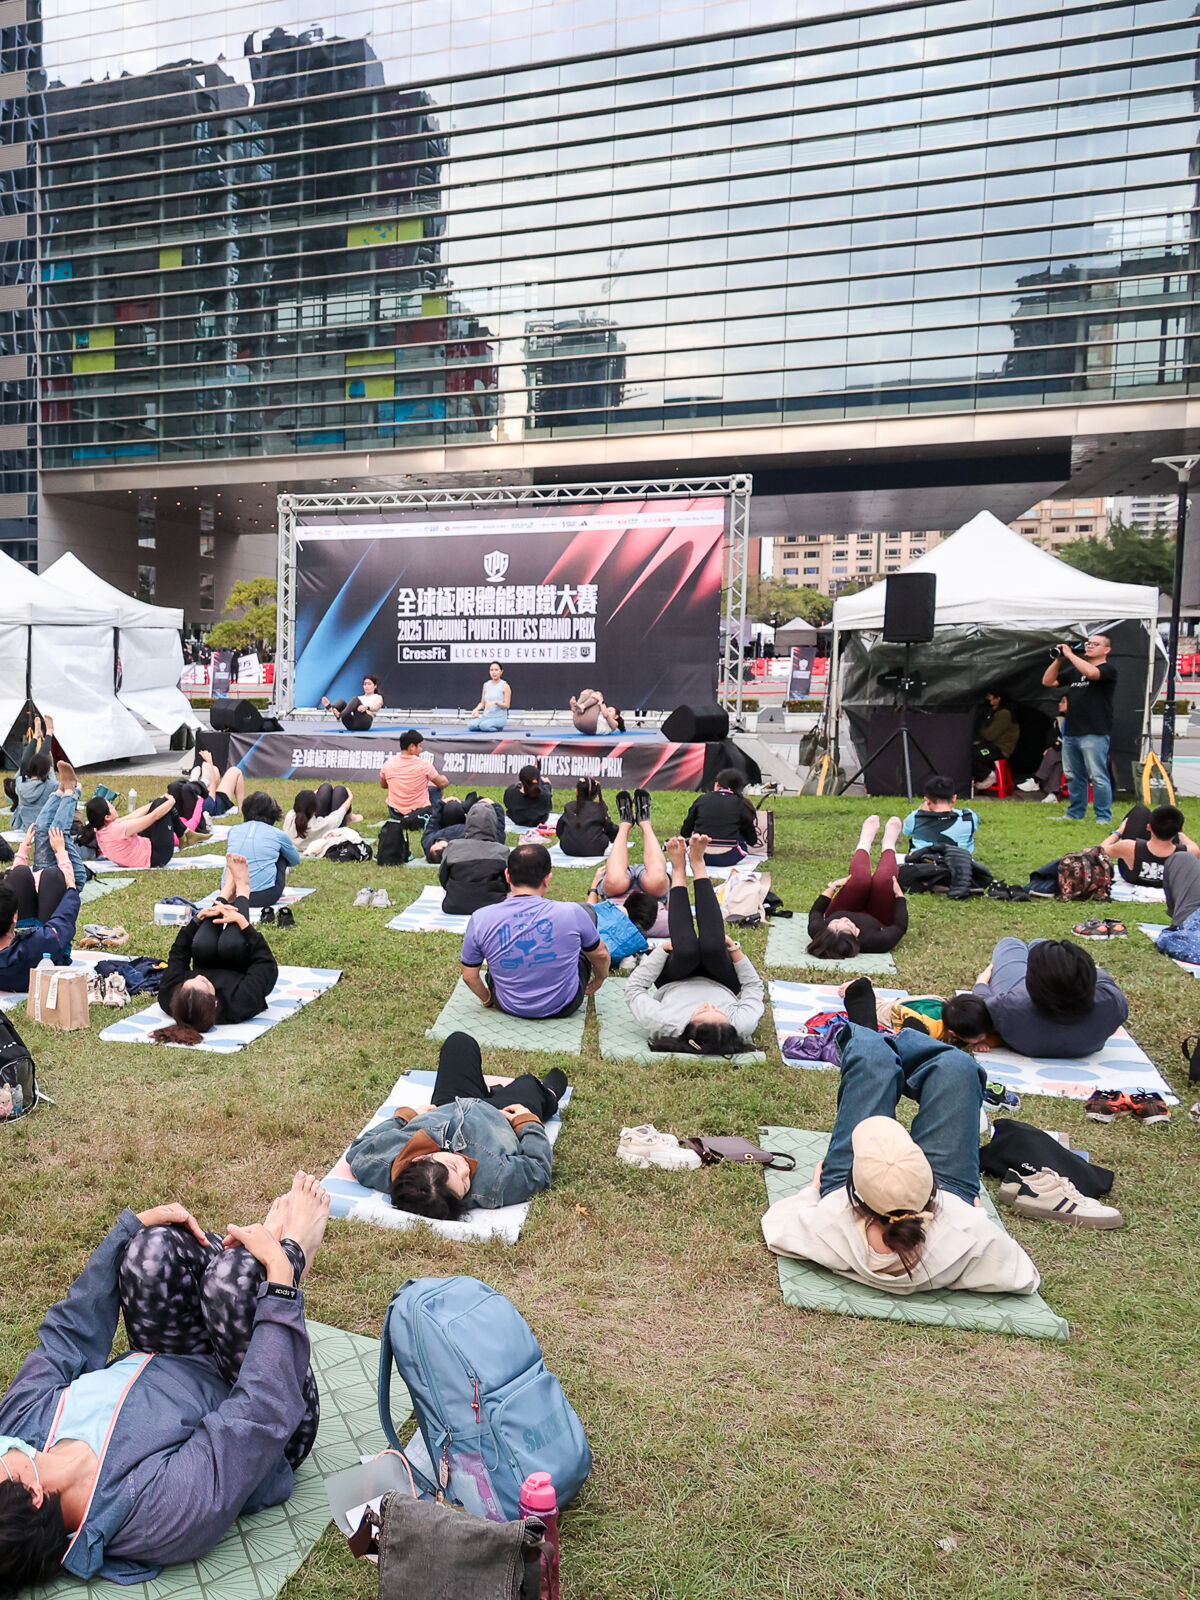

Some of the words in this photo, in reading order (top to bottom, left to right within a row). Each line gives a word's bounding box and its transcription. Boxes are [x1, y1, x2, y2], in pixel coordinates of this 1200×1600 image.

[397, 584, 599, 617] 全球極限體能鋼鐵大賽
[397, 619, 423, 641] 2025
[423, 618, 467, 641] TAICHUNG
[467, 618, 500, 641] POWER
[501, 618, 538, 640] FITNESS
[539, 617, 572, 640] GRAND
[572, 617, 596, 640] PRIX
[402, 646, 447, 660] CrossFit
[455, 649, 510, 659] LICENSED
[516, 648, 552, 658] EVENT
[442, 753, 465, 773] 2025
[466, 753, 505, 774] TAICHUNG
[571, 756, 600, 777] GRAND
[601, 757, 623, 778] PRIX
